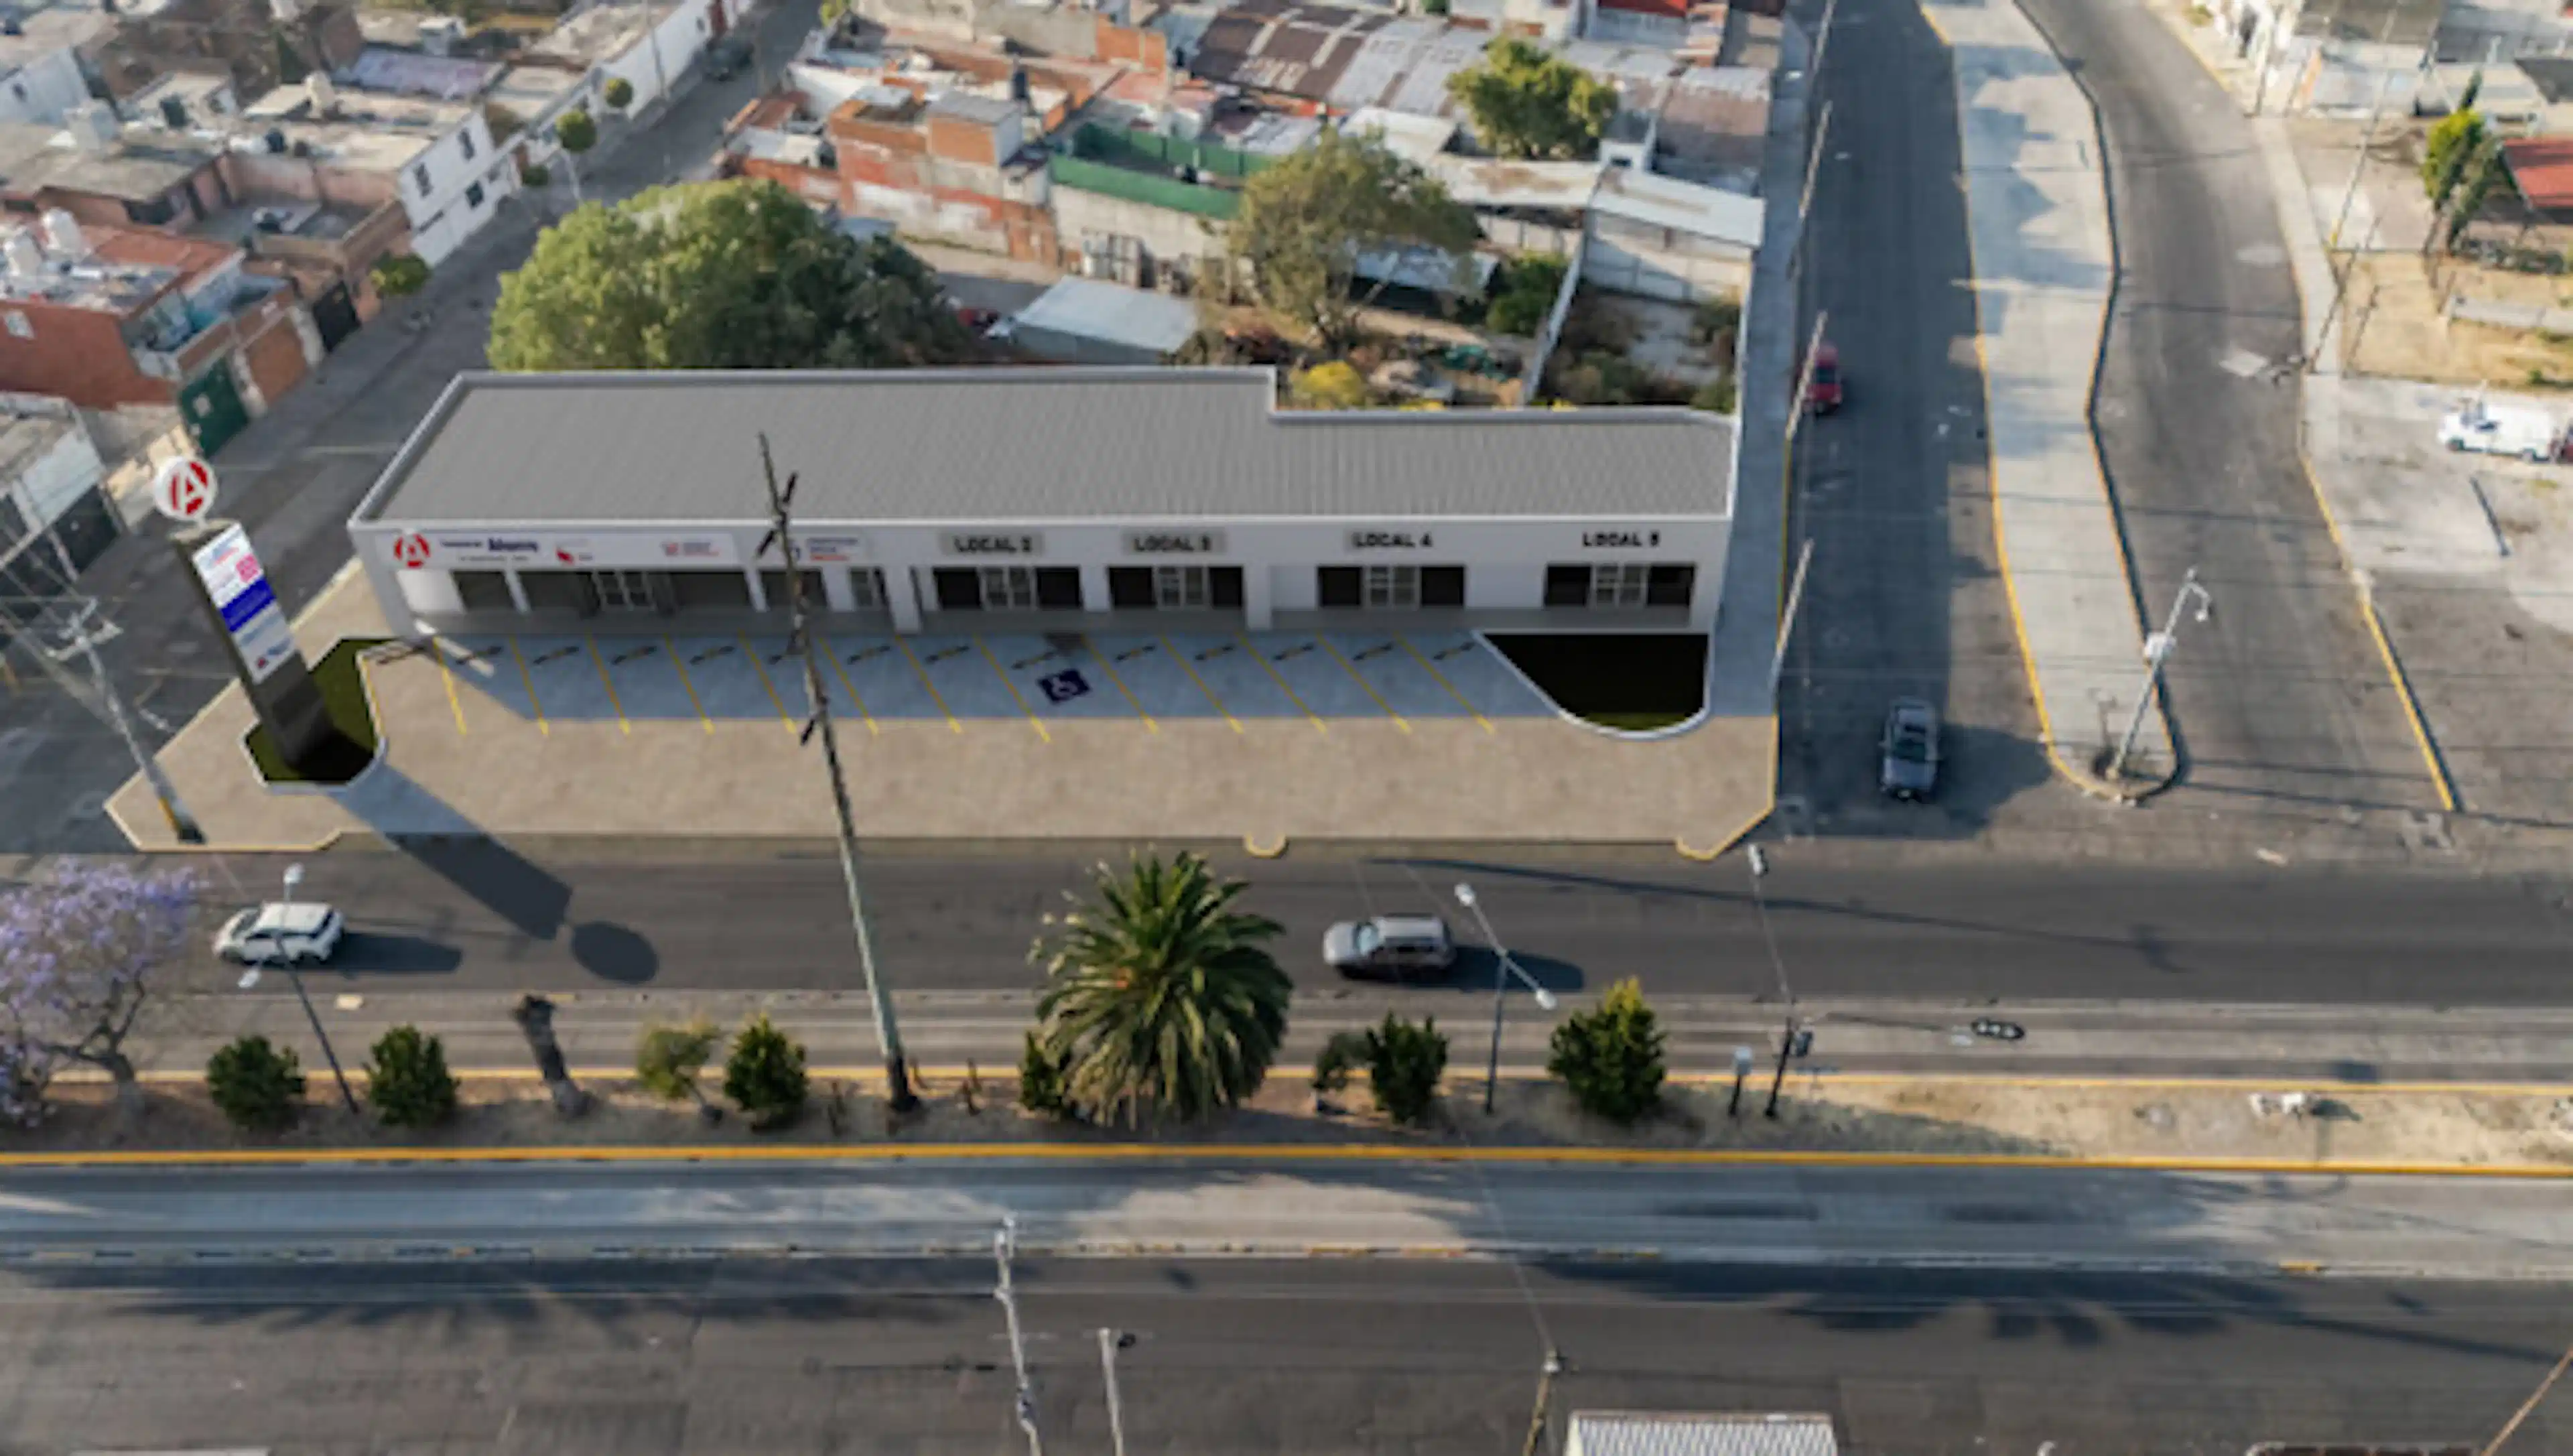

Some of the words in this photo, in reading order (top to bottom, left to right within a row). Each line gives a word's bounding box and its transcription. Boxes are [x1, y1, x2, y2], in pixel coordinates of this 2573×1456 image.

[954, 536, 1016, 552] LOCAL
[1134, 536, 1195, 552] LOCAL
[1352, 533, 1416, 547] LOCAL
[1583, 533, 1643, 547] LOCAL
